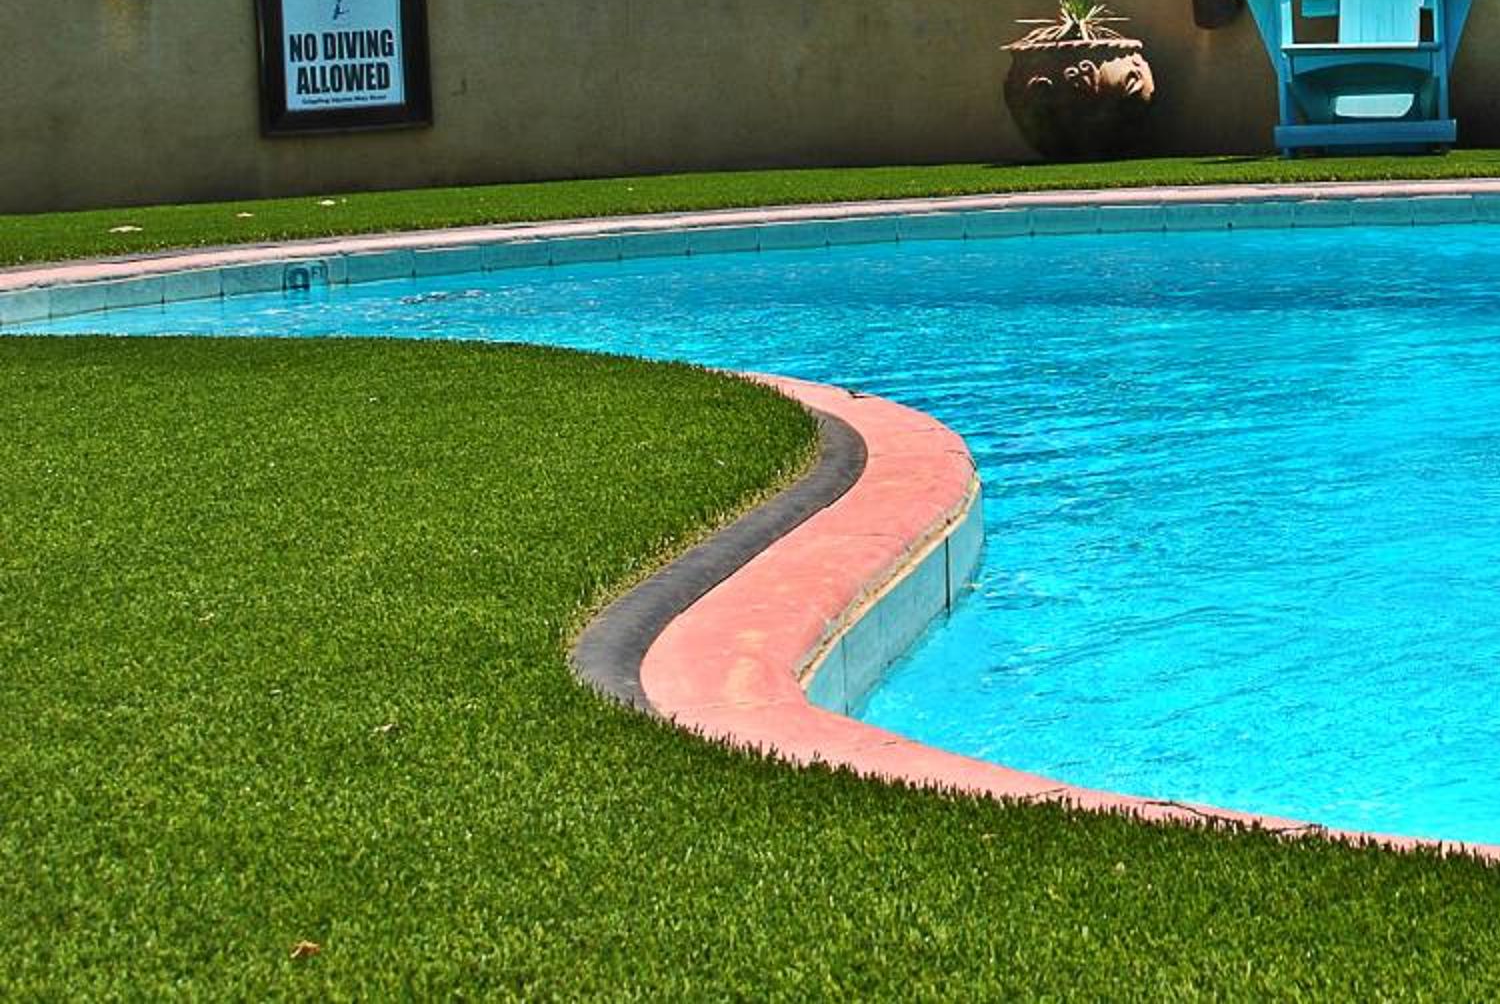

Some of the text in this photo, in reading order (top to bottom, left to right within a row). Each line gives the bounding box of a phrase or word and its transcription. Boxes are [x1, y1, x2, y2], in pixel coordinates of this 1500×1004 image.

[289, 29, 395, 63] NO DIVING
[296, 62, 391, 95] ALLOWED
